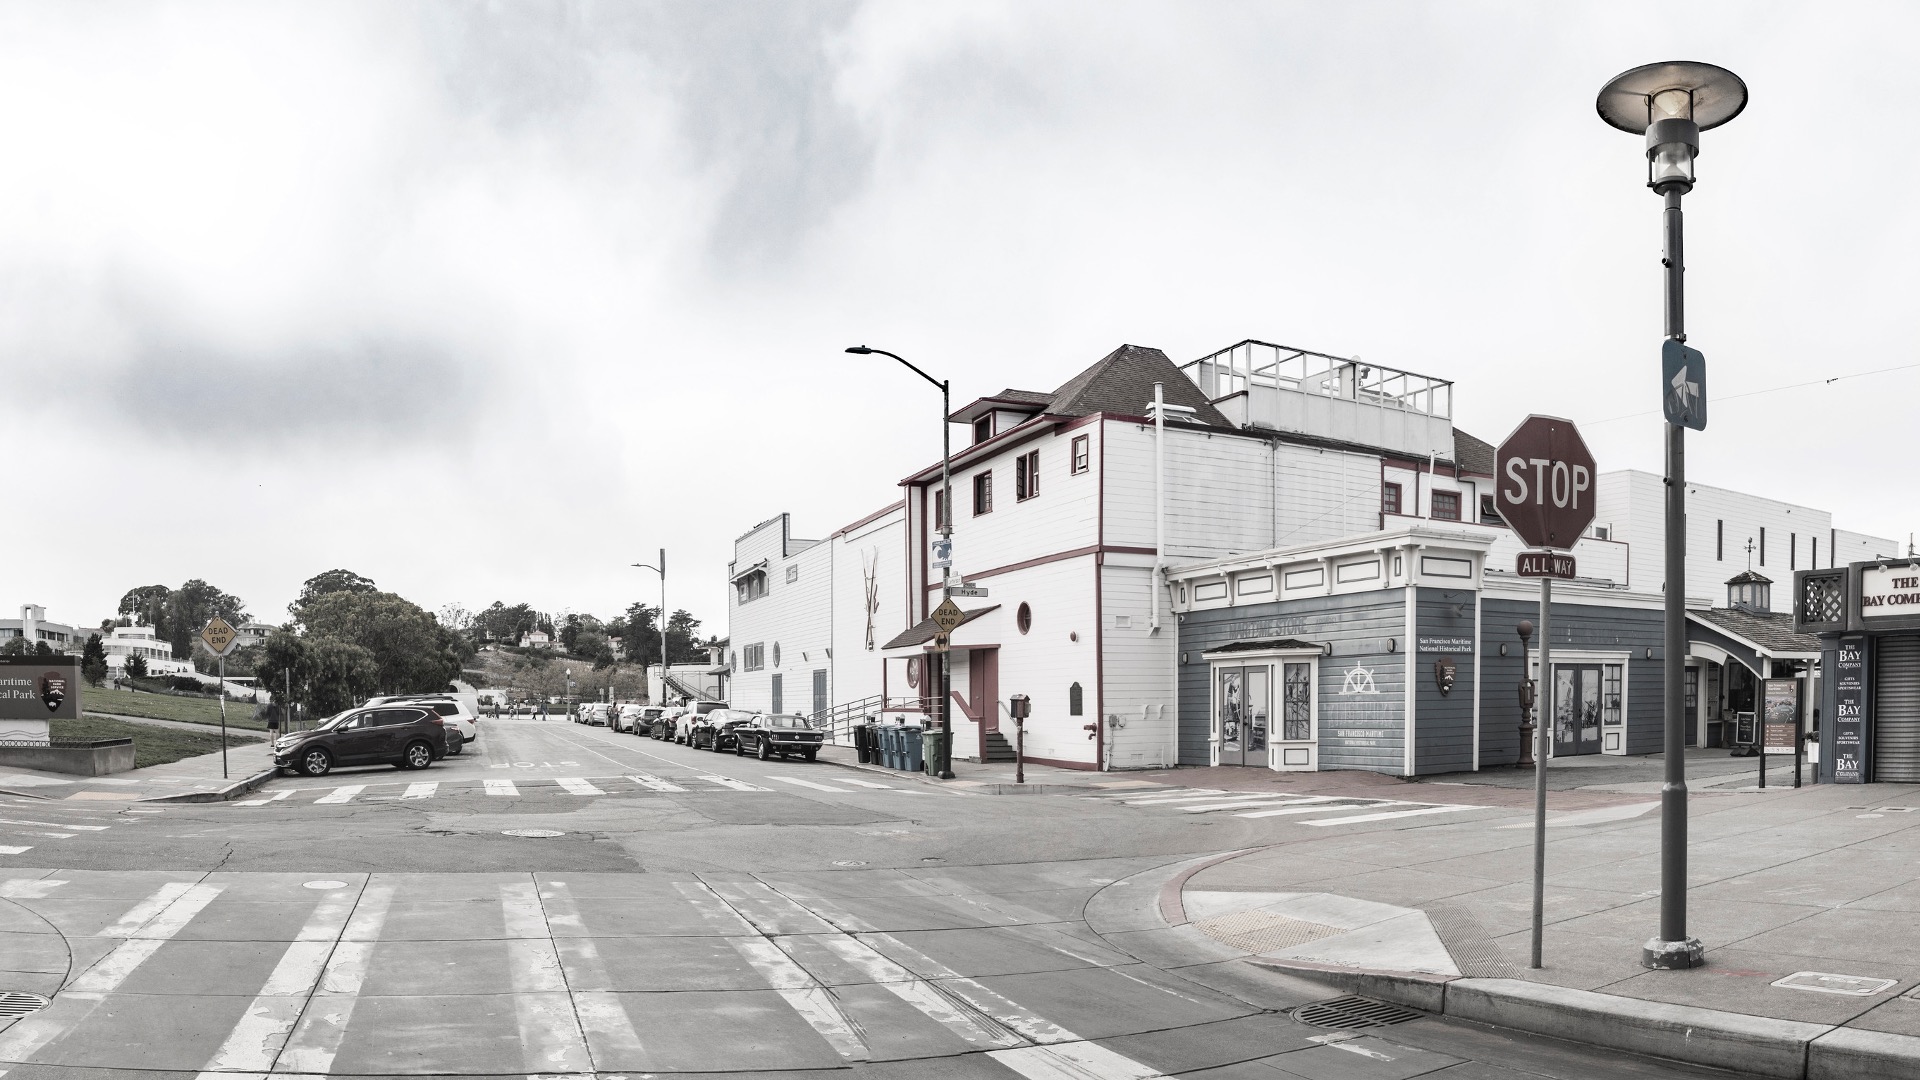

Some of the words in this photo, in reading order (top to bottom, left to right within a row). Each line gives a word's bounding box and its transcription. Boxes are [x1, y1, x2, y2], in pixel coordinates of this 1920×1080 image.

[1504, 456, 1590, 510] STOP
[1522, 557, 1548, 573] ALL
[1553, 559, 1572, 575] WAY
[1892, 577, 1918, 588] THE
[1863, 595, 1885, 606] BAY
[1276, 617, 1308, 636] STORE
[1839, 650, 1862, 662] BAY
[13, 690, 36, 699] Park
[1838, 704, 1861, 717] BAY
[1836, 758, 1859, 771] BAY
